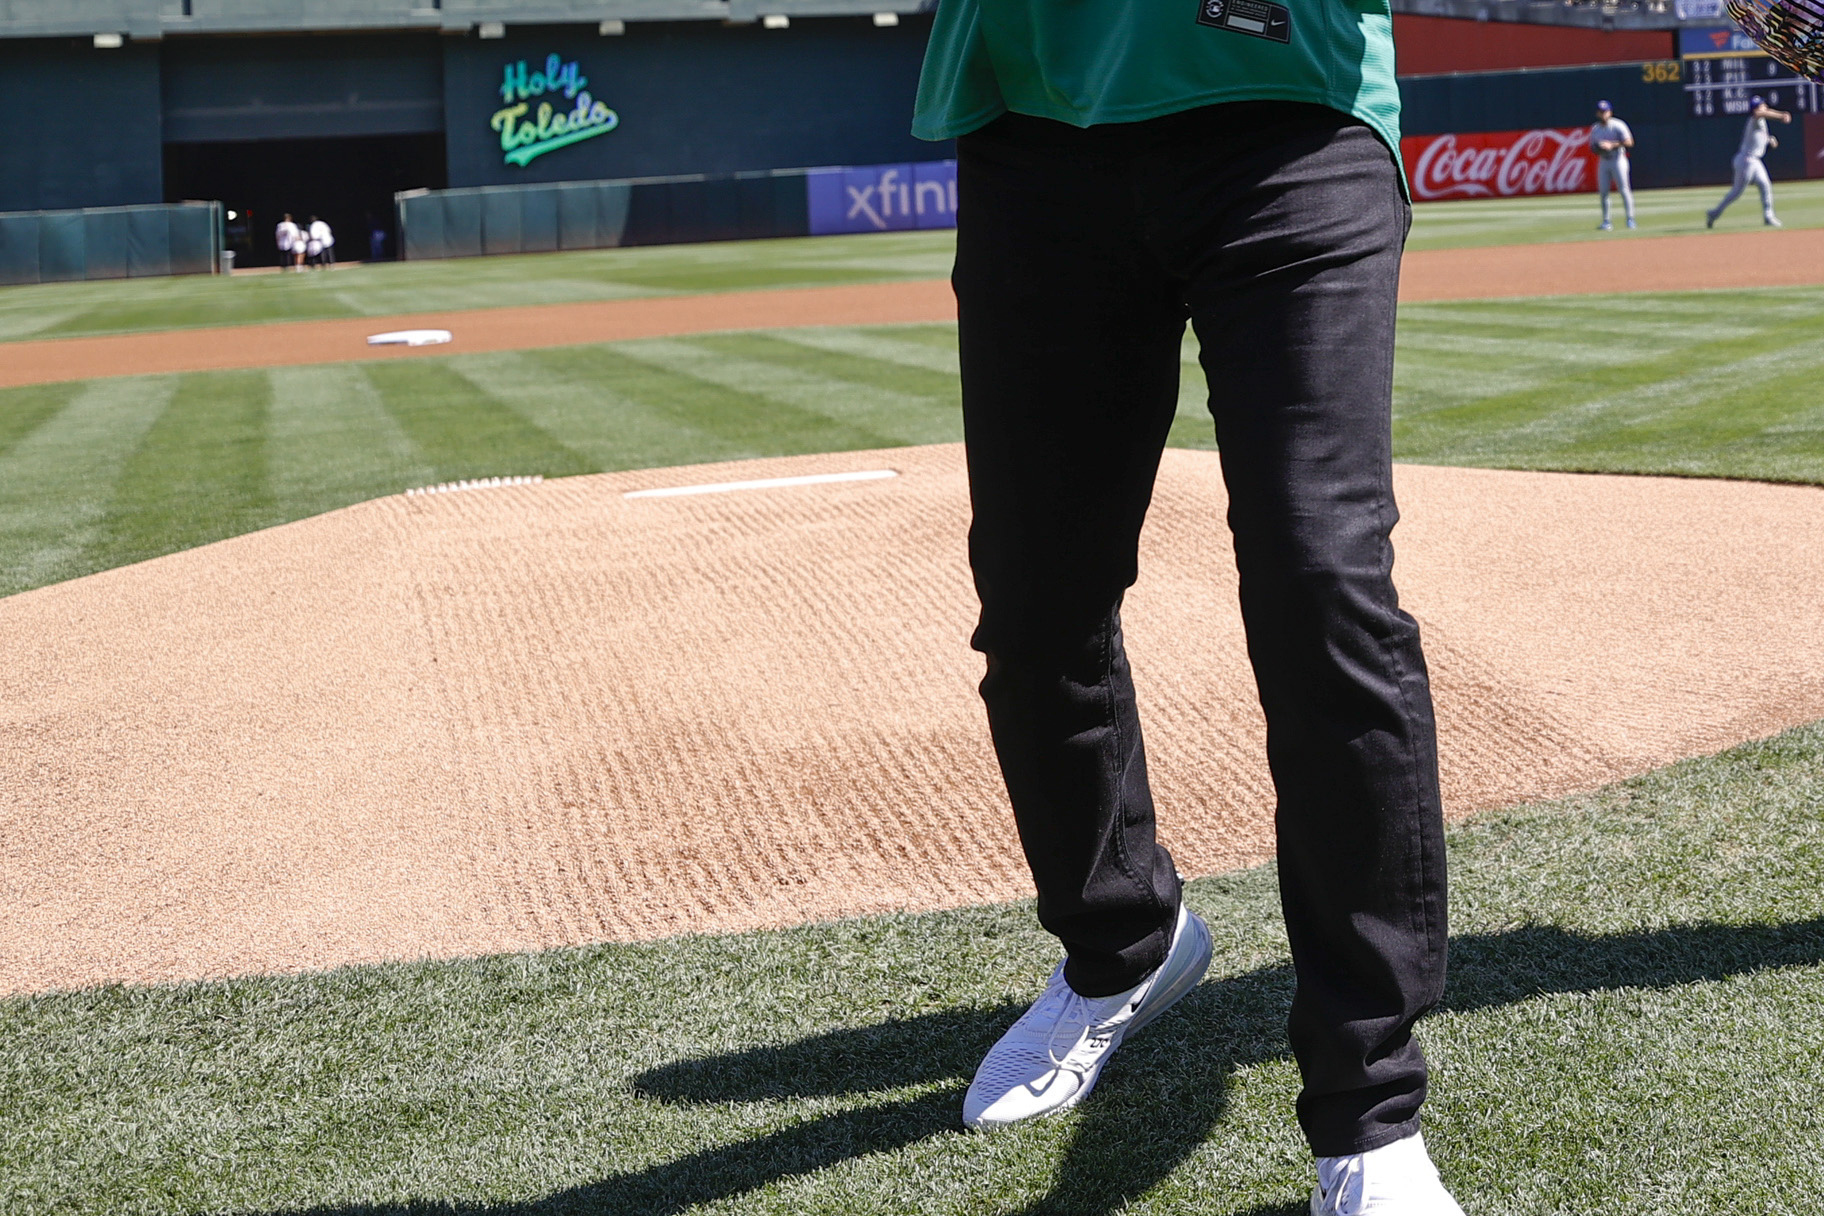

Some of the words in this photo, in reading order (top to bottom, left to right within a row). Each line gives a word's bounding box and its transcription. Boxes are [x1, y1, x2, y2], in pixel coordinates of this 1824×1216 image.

[499, 52, 589, 104] Holy
[1643, 61, 1680, 82] 362
[491, 91, 619, 152] Toledo
[1414, 129, 1590, 198] Coca-Cola
